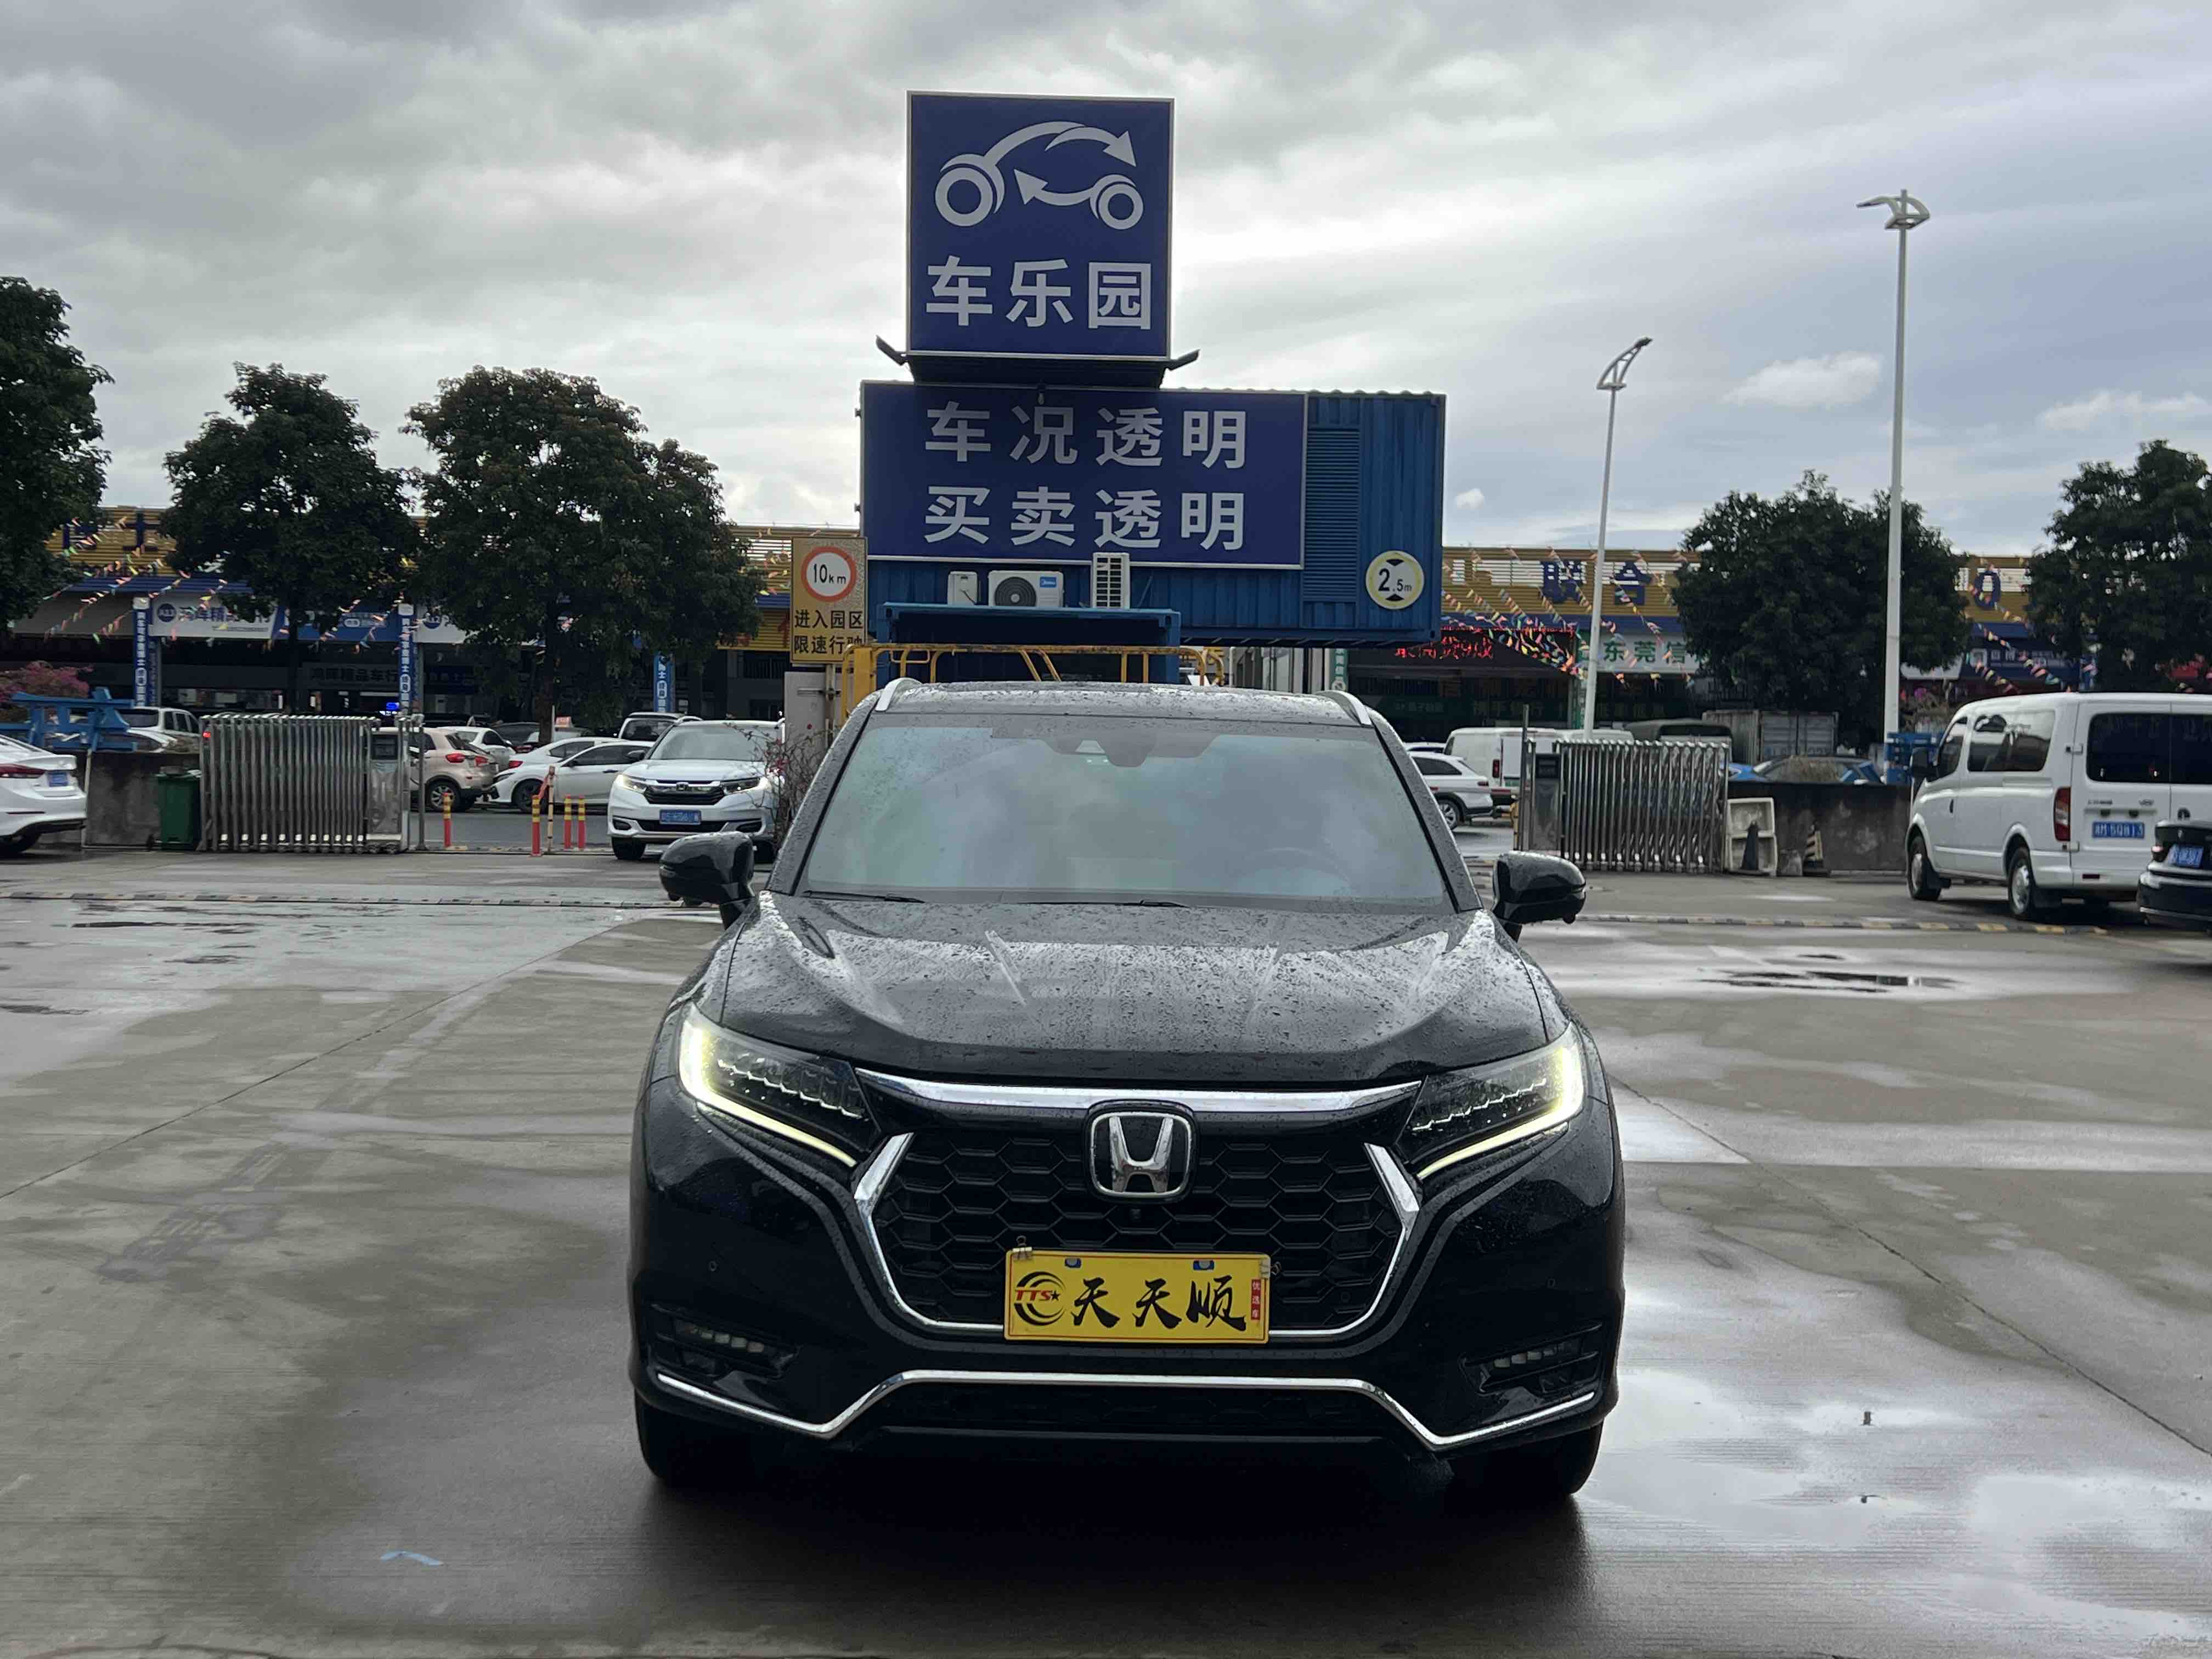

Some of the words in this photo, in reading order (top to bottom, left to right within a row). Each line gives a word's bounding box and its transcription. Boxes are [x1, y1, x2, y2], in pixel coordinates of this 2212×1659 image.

[926, 255, 1151, 329] 车乐园
[925, 401, 1246, 469] 车况透明
[924, 486, 1244, 550] 买卖透明
[814, 563, 847, 584] 10km
[1378, 568, 1412, 591] 2.5m
[794, 610, 863, 629] 进入园区
[1014, 1289, 1053, 1301] TTS
[1071, 1275, 1246, 1331] 天天顺
